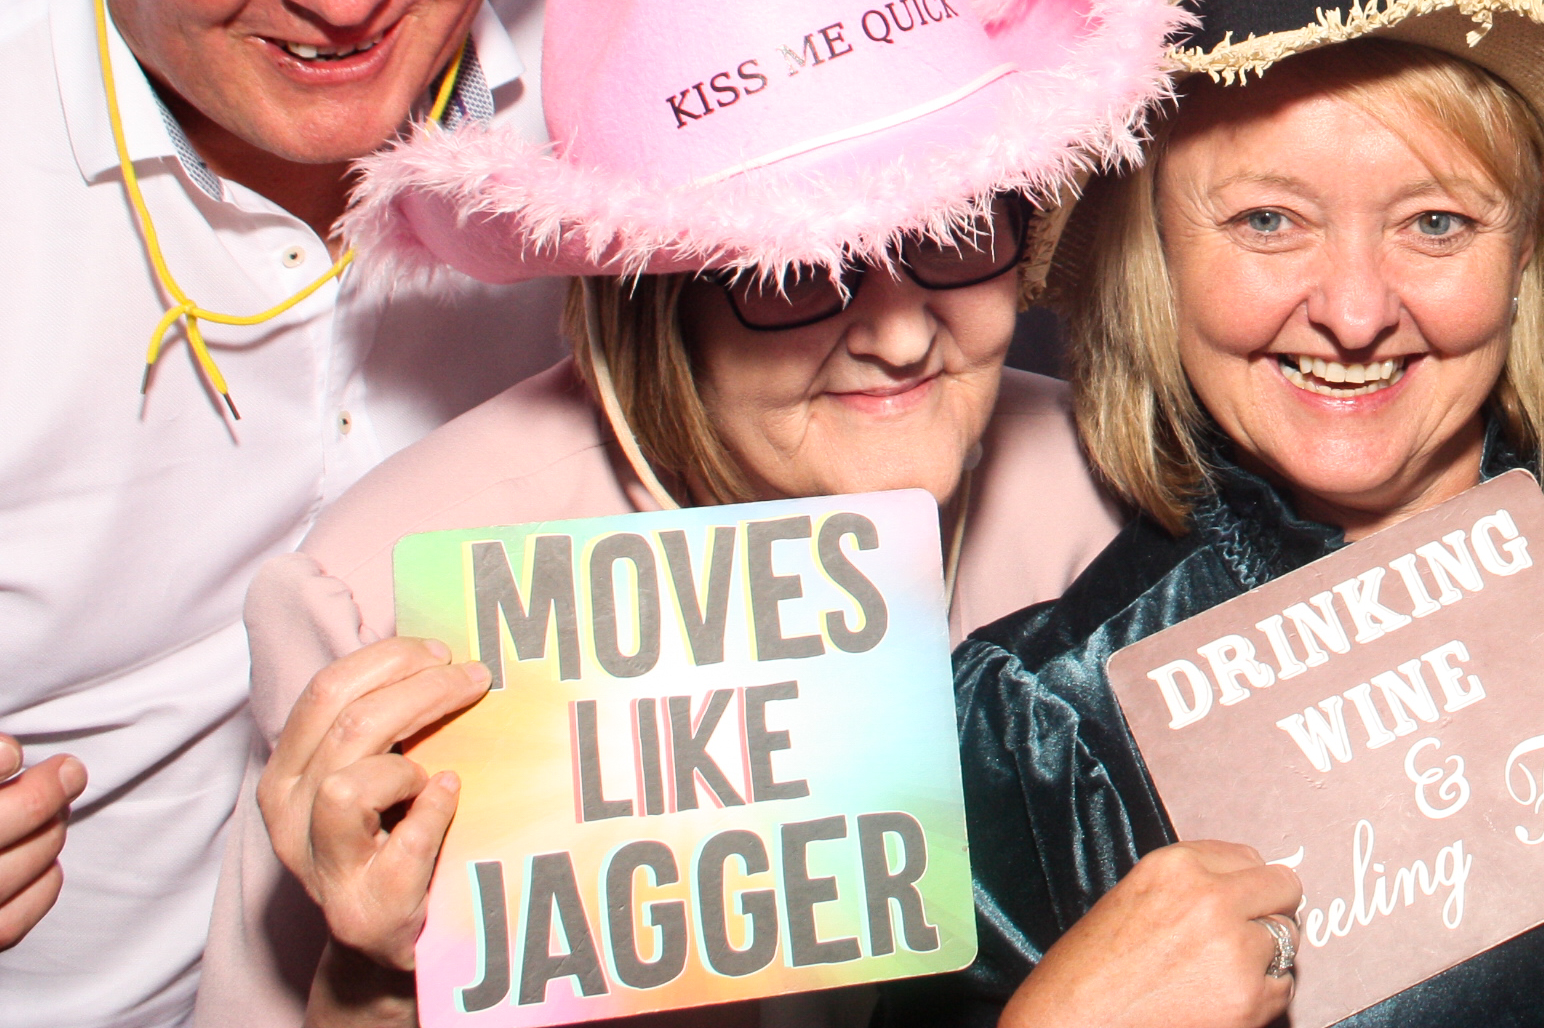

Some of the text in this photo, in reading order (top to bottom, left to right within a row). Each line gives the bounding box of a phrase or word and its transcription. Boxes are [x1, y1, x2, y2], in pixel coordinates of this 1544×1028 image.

[666, 59, 768, 129] KISS
[776, 22, 853, 77] ME
[463, 512, 889, 691] MOVES
[1146, 508, 1534, 731] DRINKING
[569, 680, 811, 823] LIKE
[1277, 640, 1486, 772] WINE
[1404, 737, 1471, 819] &
[454, 811, 940, 1013] JAGGER
[1265, 819, 1473, 947] eeling
